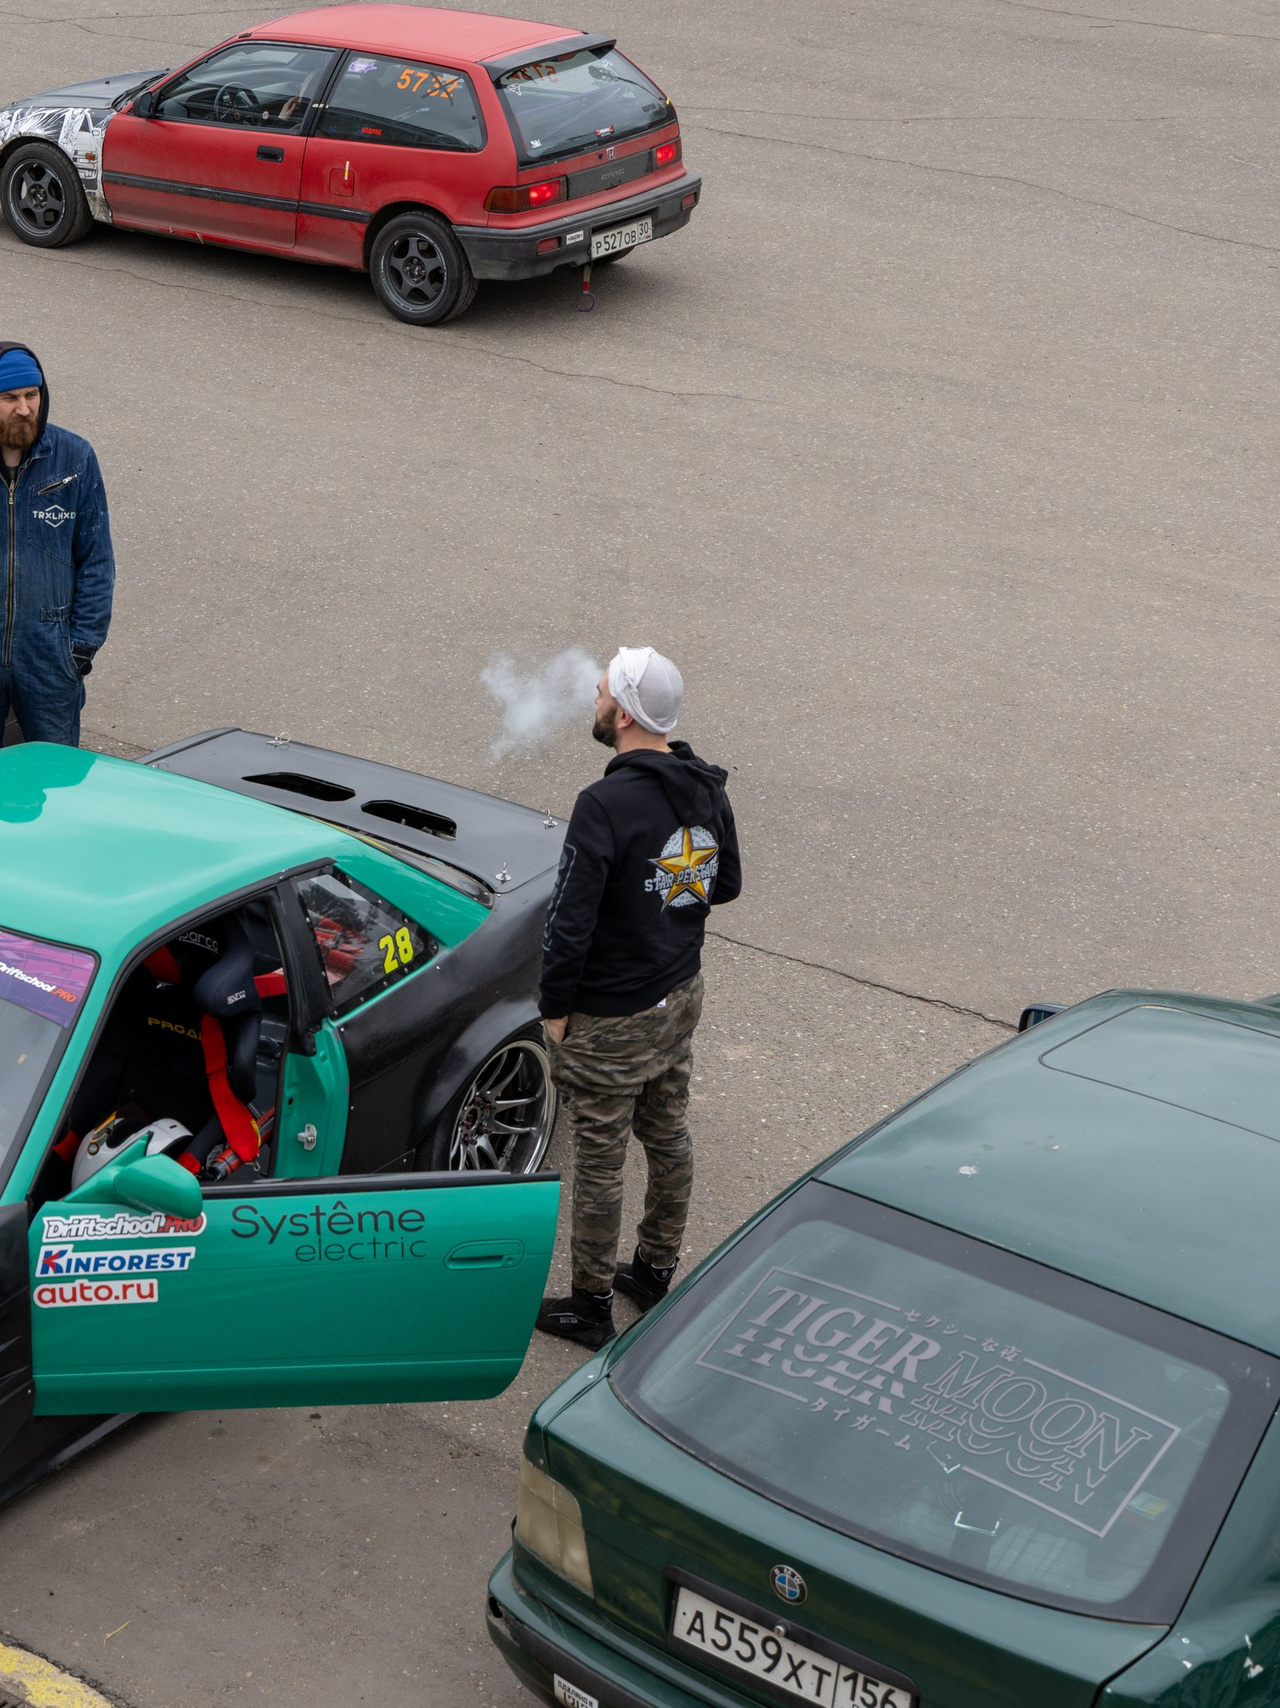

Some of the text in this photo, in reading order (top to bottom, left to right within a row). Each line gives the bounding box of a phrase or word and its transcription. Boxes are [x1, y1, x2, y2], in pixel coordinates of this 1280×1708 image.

[178, 931, 218, 953] parco
[379, 926, 414, 974] 28
[230, 1200, 426, 1245] Systême
[39, 1249, 192, 1275] KINFOREST
[295, 1236, 427, 1263] electric
[37, 1282, 155, 1305] auto.ru
[748, 1285, 1154, 1472] TIGER MOON
[773, 1567, 803, 1586] BMW
